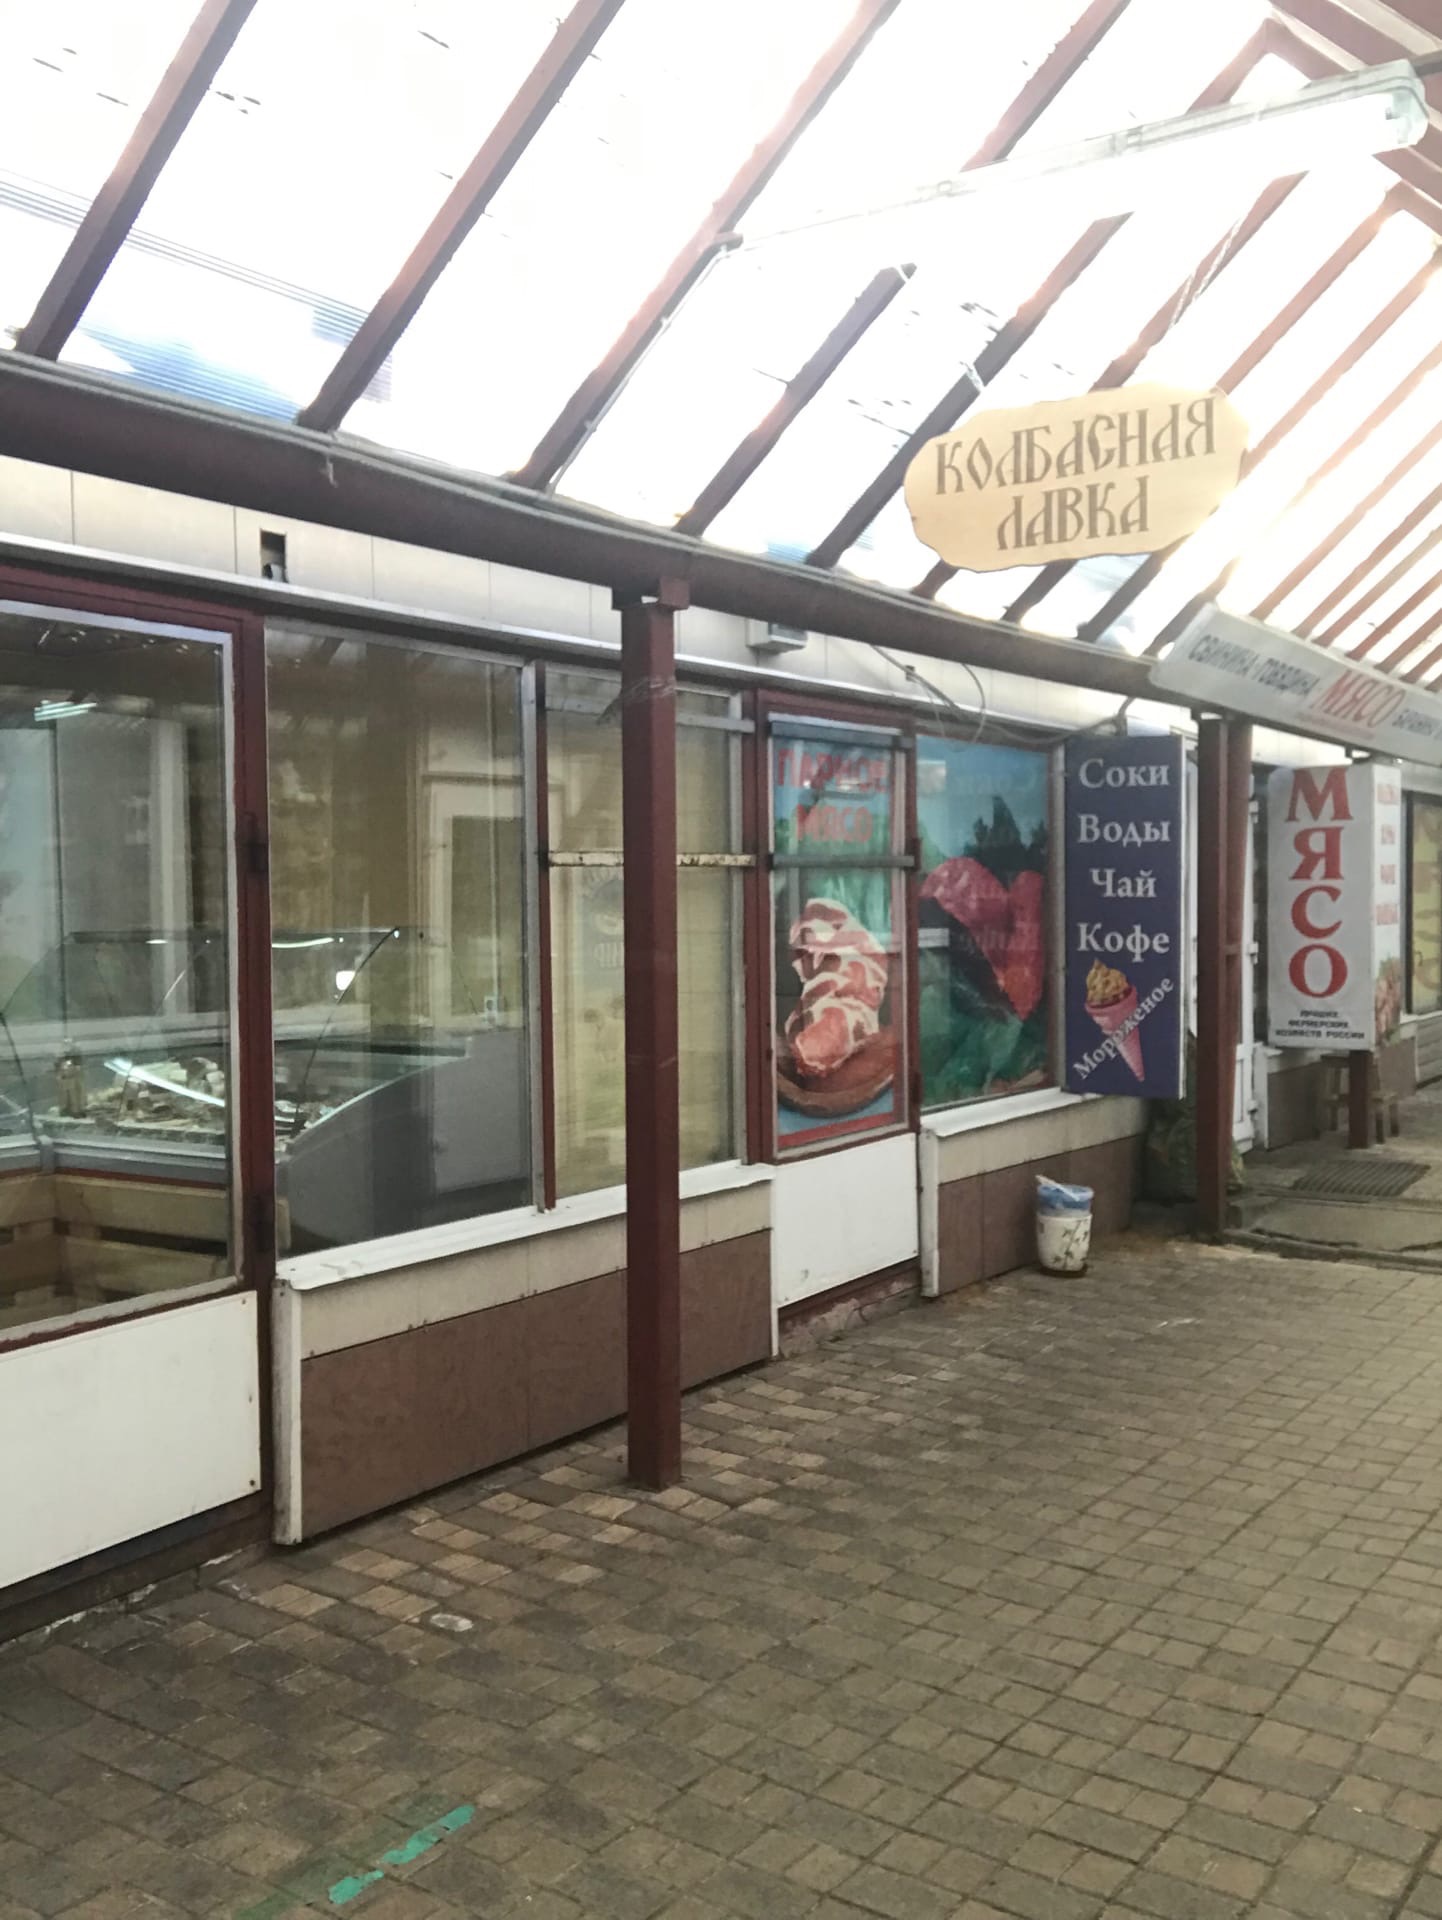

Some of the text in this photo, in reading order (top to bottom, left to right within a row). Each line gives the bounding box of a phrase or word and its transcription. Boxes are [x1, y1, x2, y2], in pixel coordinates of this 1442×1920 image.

[935, 396, 1216, 496] КОЛБАСНАЯ
[996, 475, 1150, 551] ЛАВКА
[1310, 669, 1406, 728] МЯСО
[1078, 758, 1170, 788] Соки
[1077, 814, 1171, 847] Воды
[1089, 868, 1157, 898] Чай
[1285, 767, 1353, 998] МЯСО
[1077, 922, 1170, 963] Кофе
[1072, 977, 1174, 1080] Мороженое
